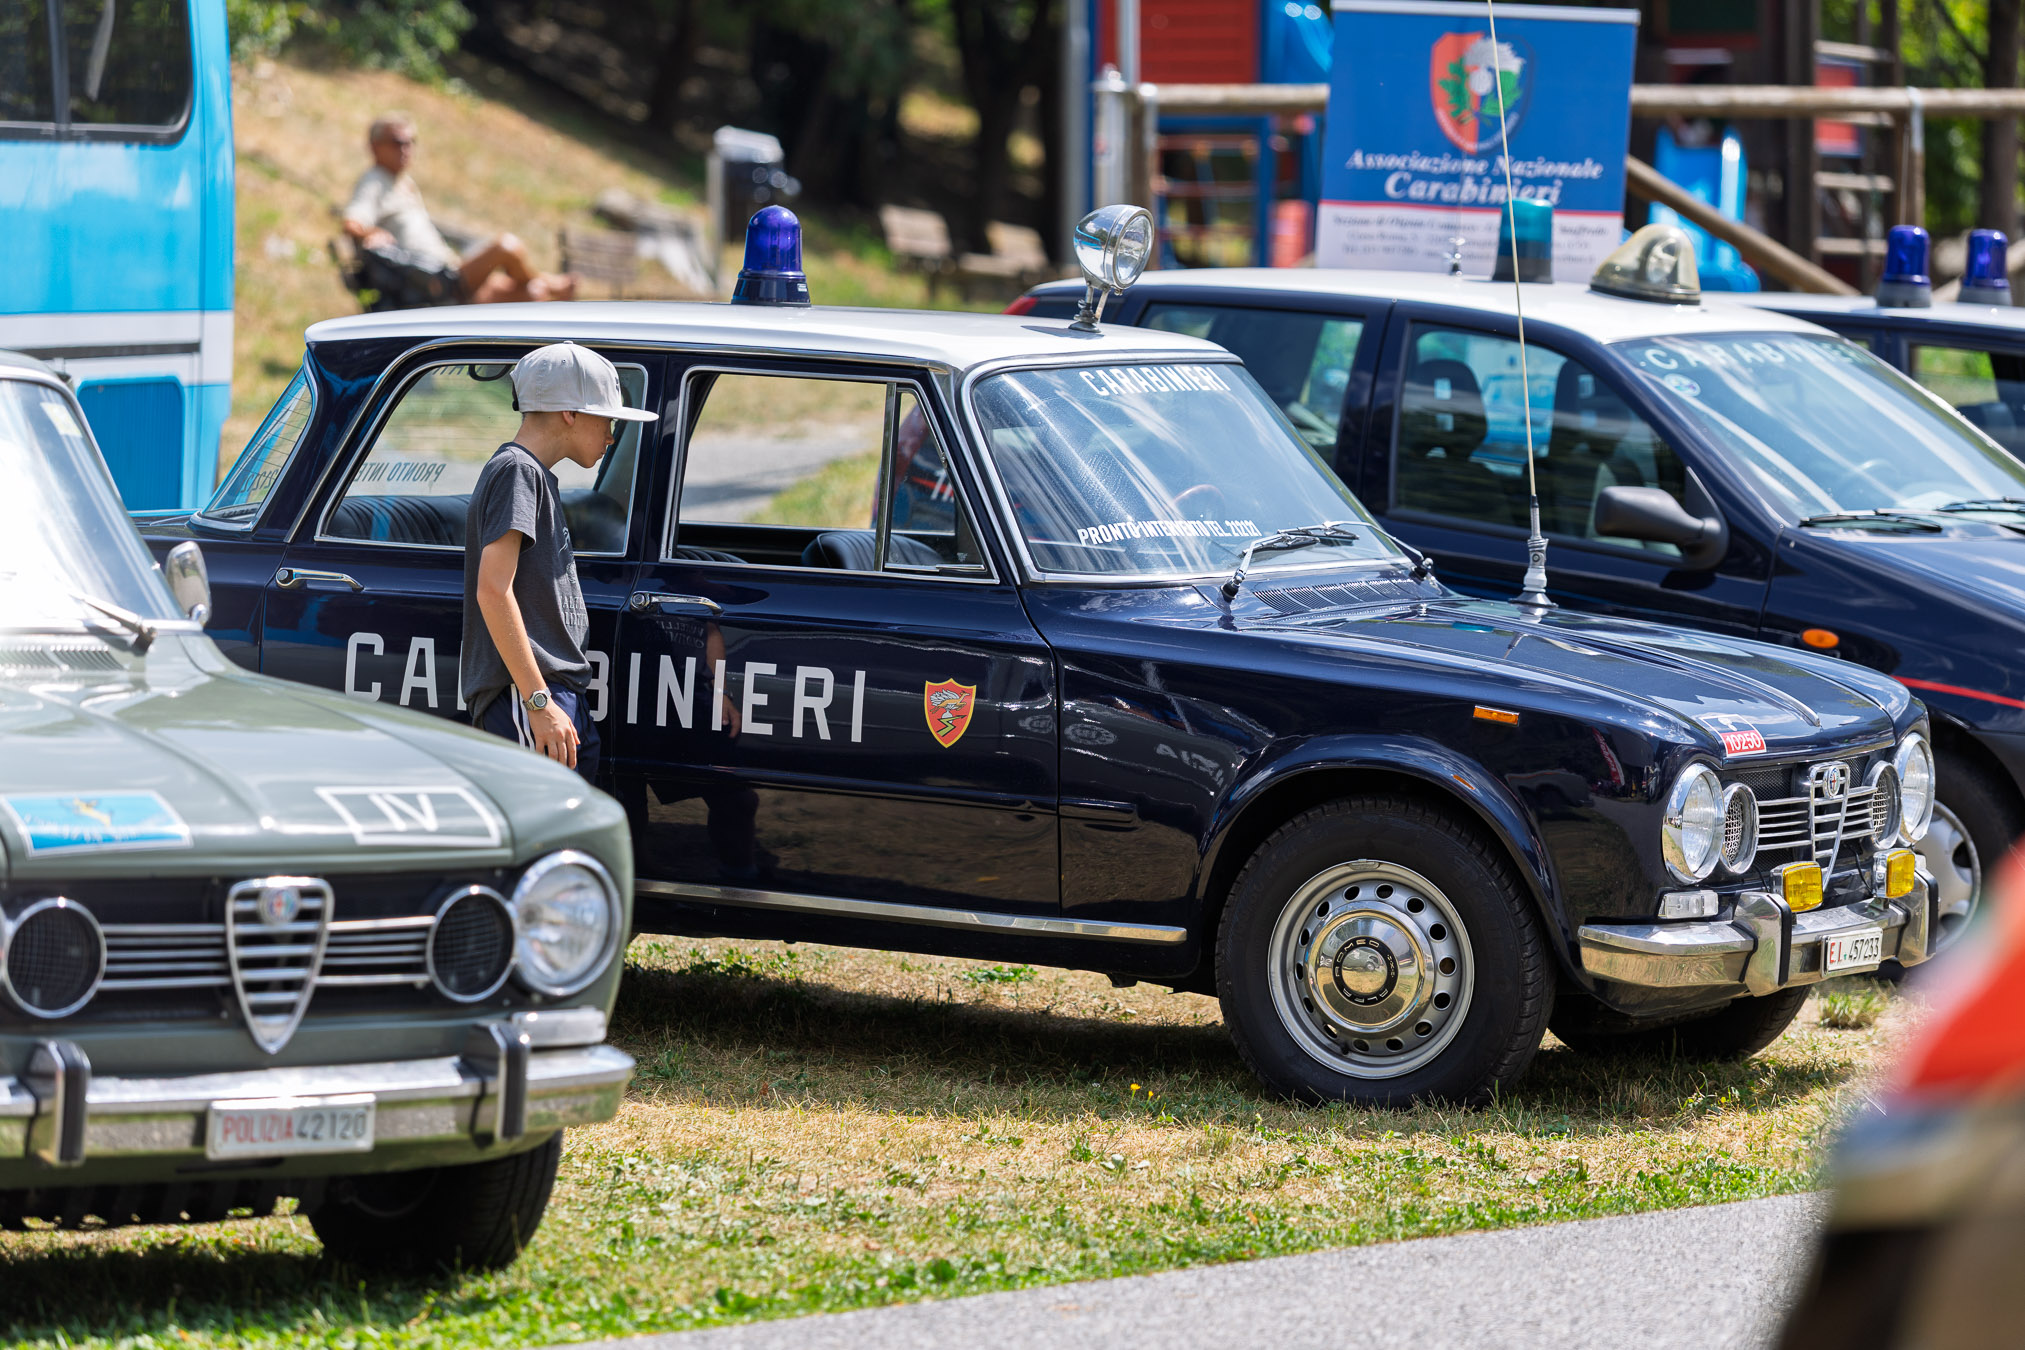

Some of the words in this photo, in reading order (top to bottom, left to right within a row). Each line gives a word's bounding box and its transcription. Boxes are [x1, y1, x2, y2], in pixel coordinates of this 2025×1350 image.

[1347, 151, 1489, 174] Associazione
[1491, 155, 1603, 179] Nazionale
[1384, 172, 1562, 205] Carabinieri
[1079, 367, 1231, 396] CARABINIERI
[1076, 522, 1141, 546] PRONTO
[1137, 520, 1211, 537] INTERVENTO
[345, 632, 867, 743] CABINIERI
[1726, 732, 1761, 751] 10250
[1848, 937, 1880, 962] 457233
[222, 1113, 294, 1144] POLIZIA
[296, 1110, 368, 1141] 42120
